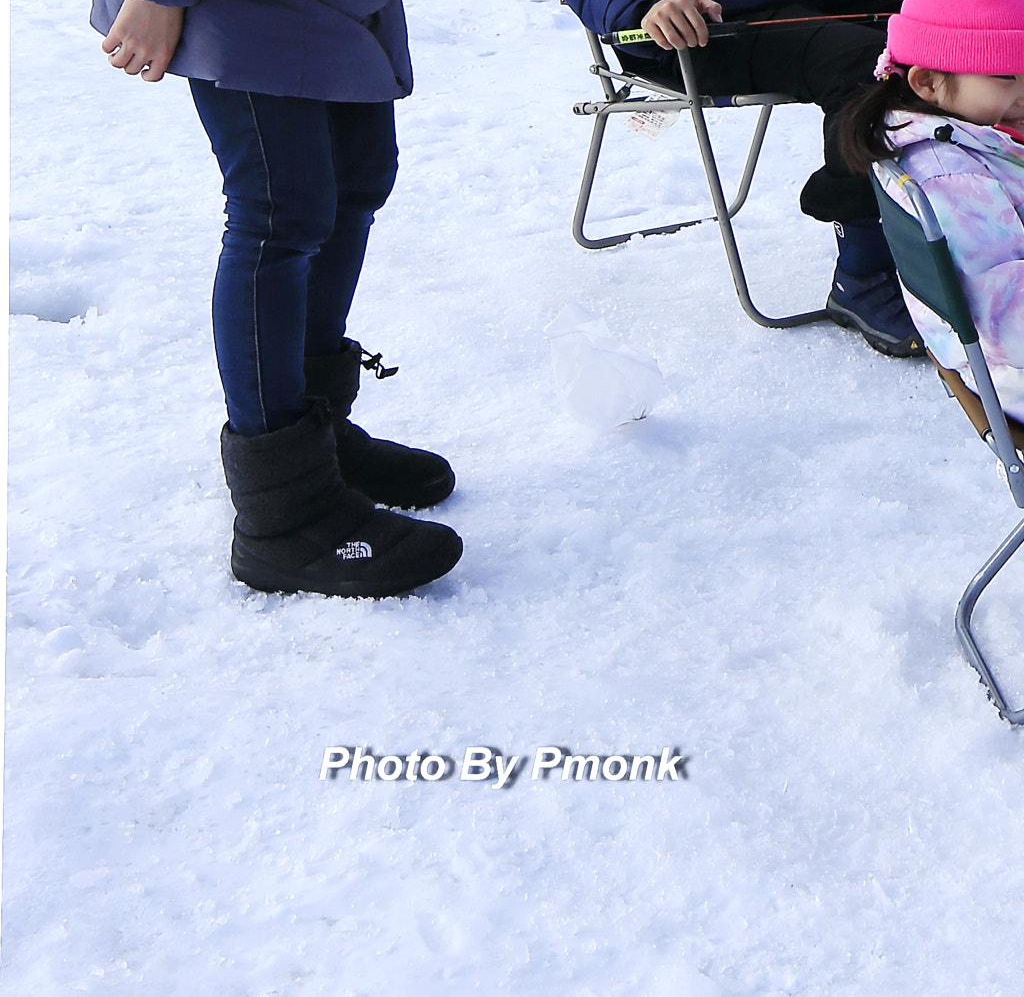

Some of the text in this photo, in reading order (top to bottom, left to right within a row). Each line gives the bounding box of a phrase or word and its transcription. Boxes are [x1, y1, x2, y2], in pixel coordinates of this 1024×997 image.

[346, 541, 360, 549] THE
[336, 547, 360, 556] NORTH
[342, 552, 360, 560] FACE
